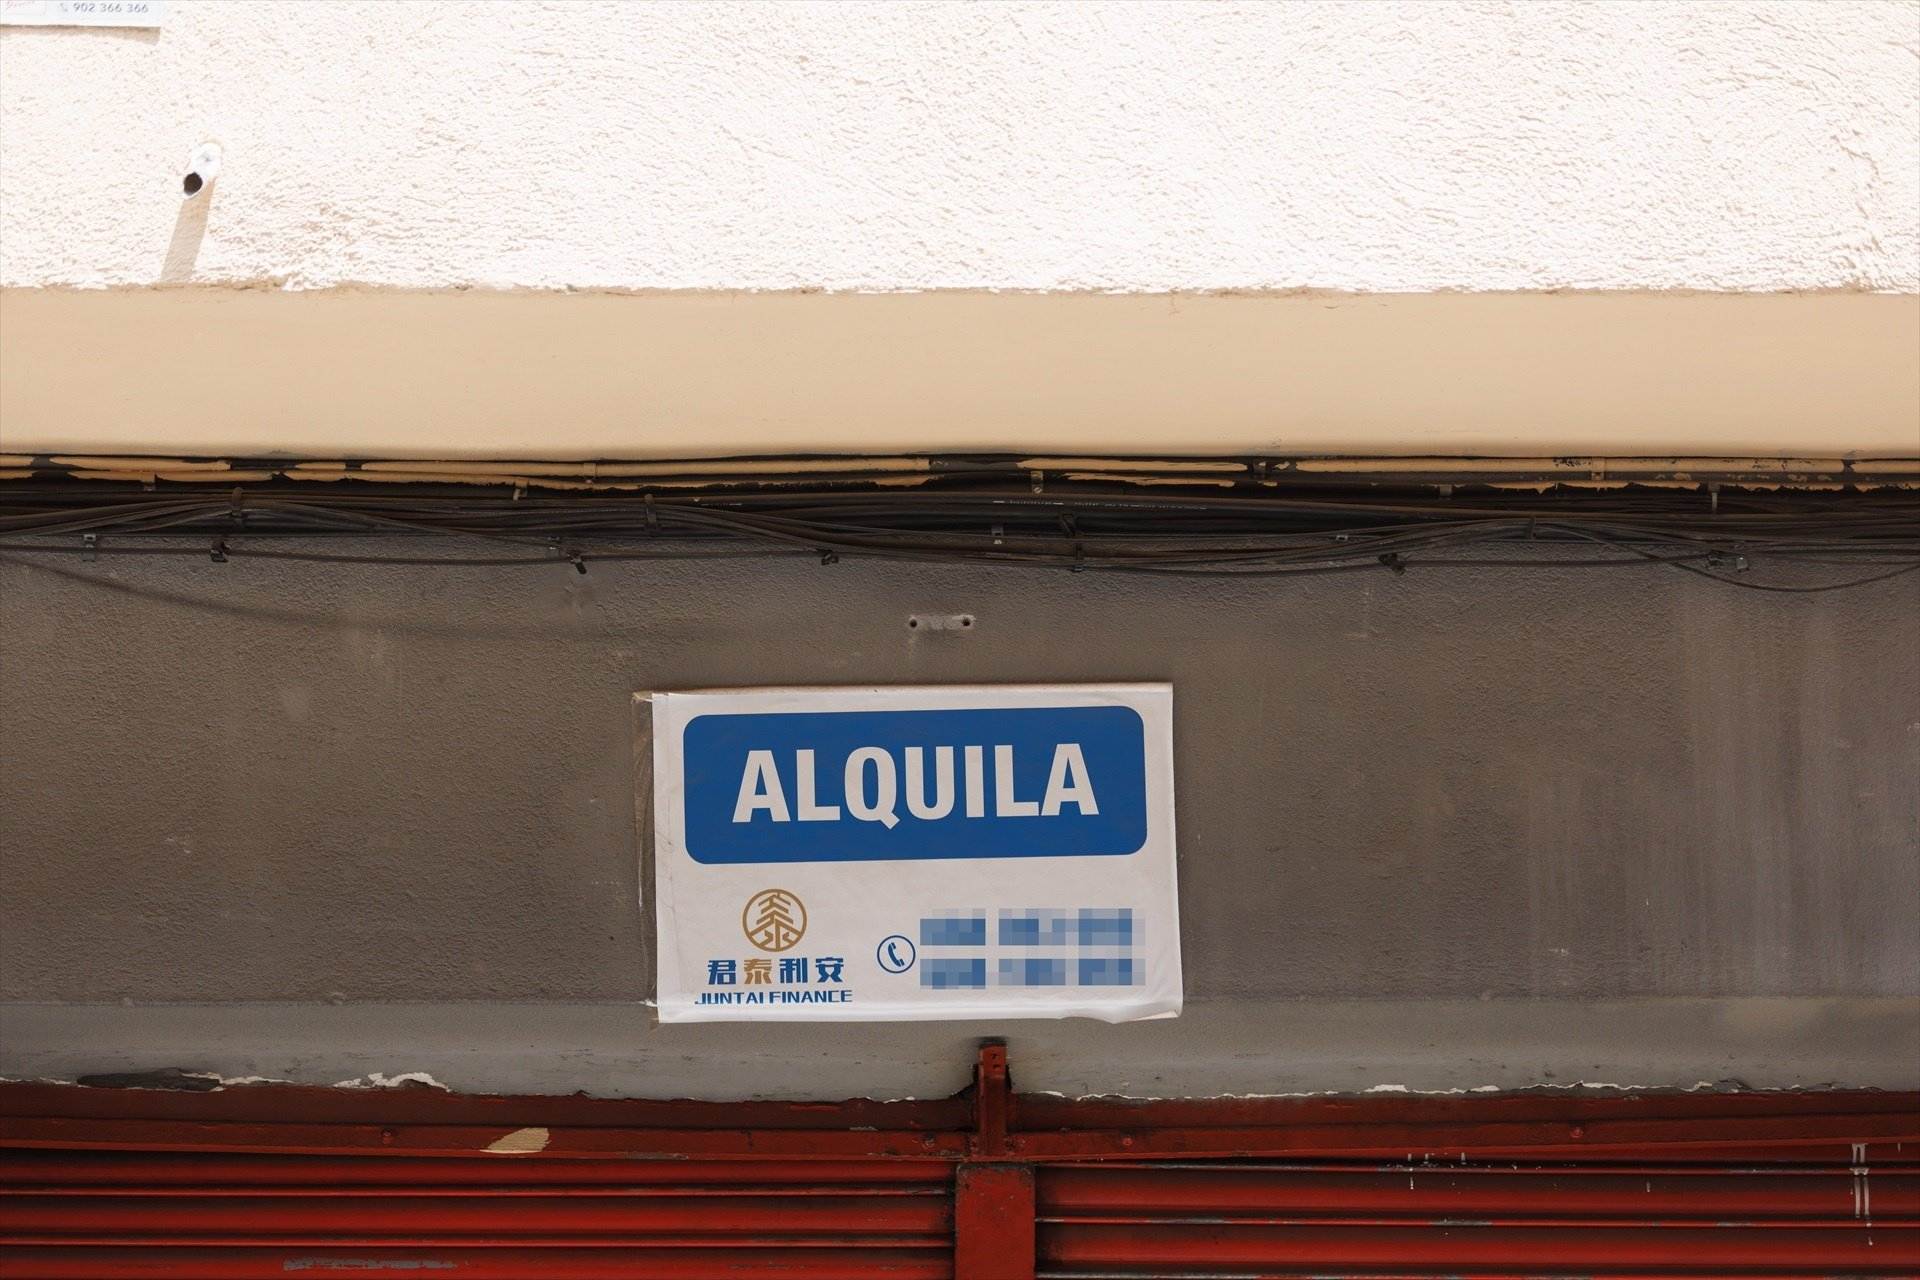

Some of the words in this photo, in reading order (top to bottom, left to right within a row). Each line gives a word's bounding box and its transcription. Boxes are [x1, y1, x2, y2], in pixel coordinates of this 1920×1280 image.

[73, 2, 96, 13] 902
[99, 2, 123, 13] 366
[126, 3, 150, 14] 366
[732, 743, 1100, 830] ALQUILA
[707, 957, 845, 985] 君泰利安
[694, 991, 764, 1005] JUNTAI
[769, 990, 853, 1004] FINANCE
